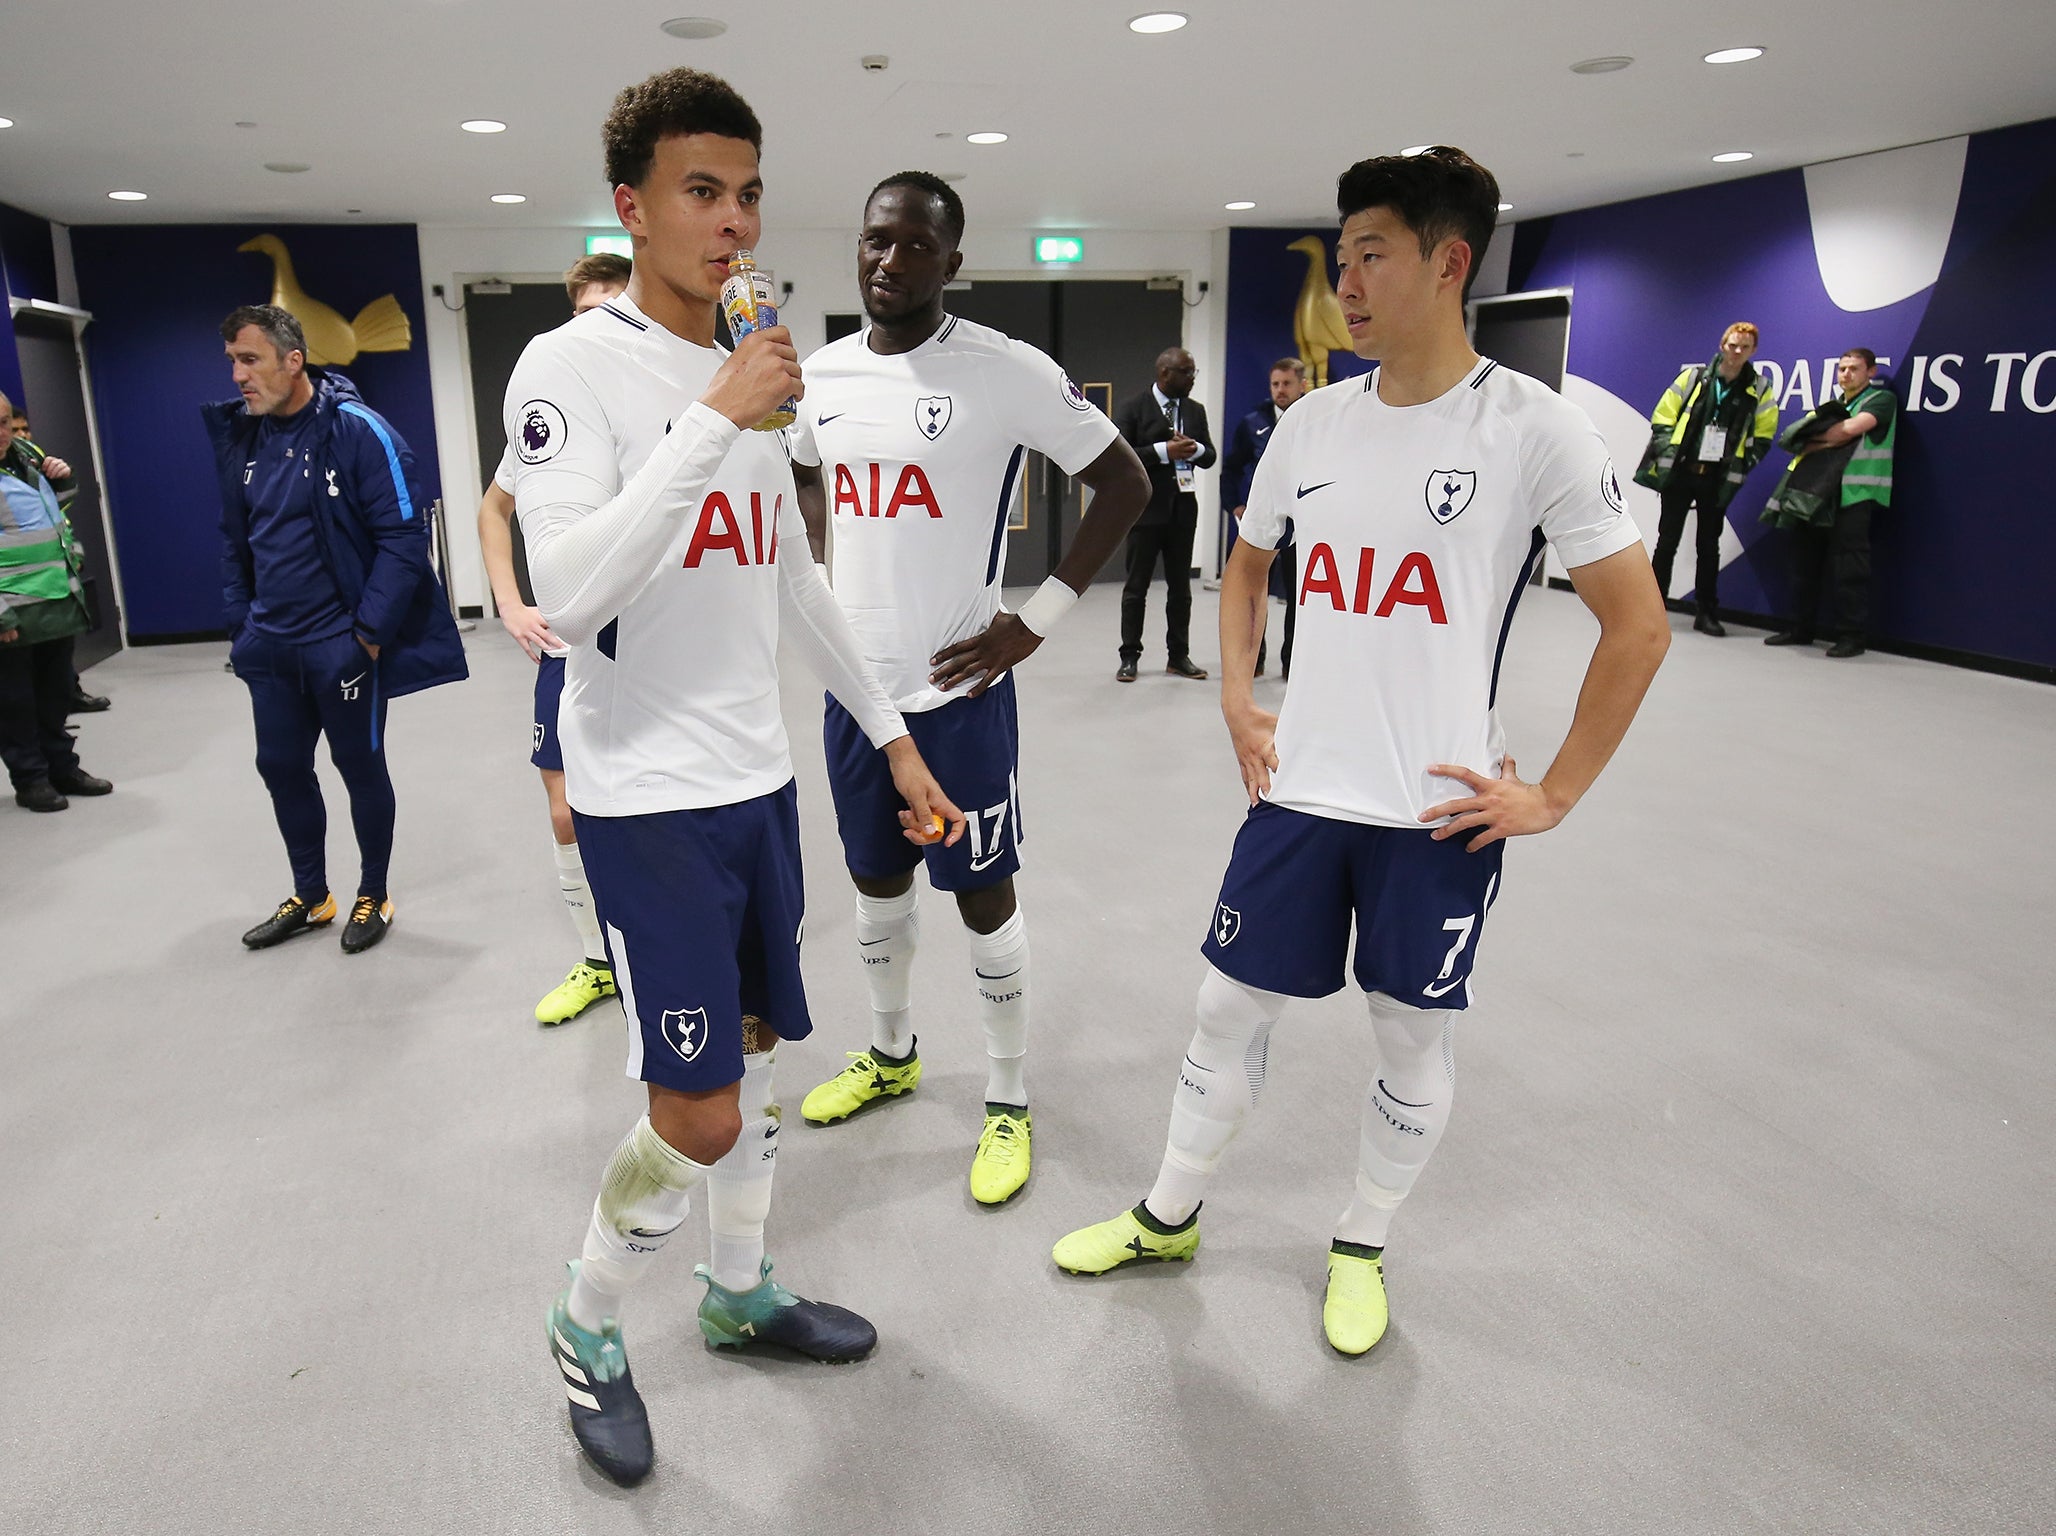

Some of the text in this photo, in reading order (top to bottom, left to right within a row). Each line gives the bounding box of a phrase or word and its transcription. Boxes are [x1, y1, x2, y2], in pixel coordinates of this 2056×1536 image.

[1905, 353, 1964, 413] IS
[834, 462, 943, 518] AIA
[1299, 542, 1448, 625] AIA
[340, 686, 359, 701] TJ
[963, 798, 1009, 858] 17
[1436, 913, 1476, 980] 7
[978, 988, 1022, 1004] SPURS
[1371, 1095, 1425, 1136] SPURS
